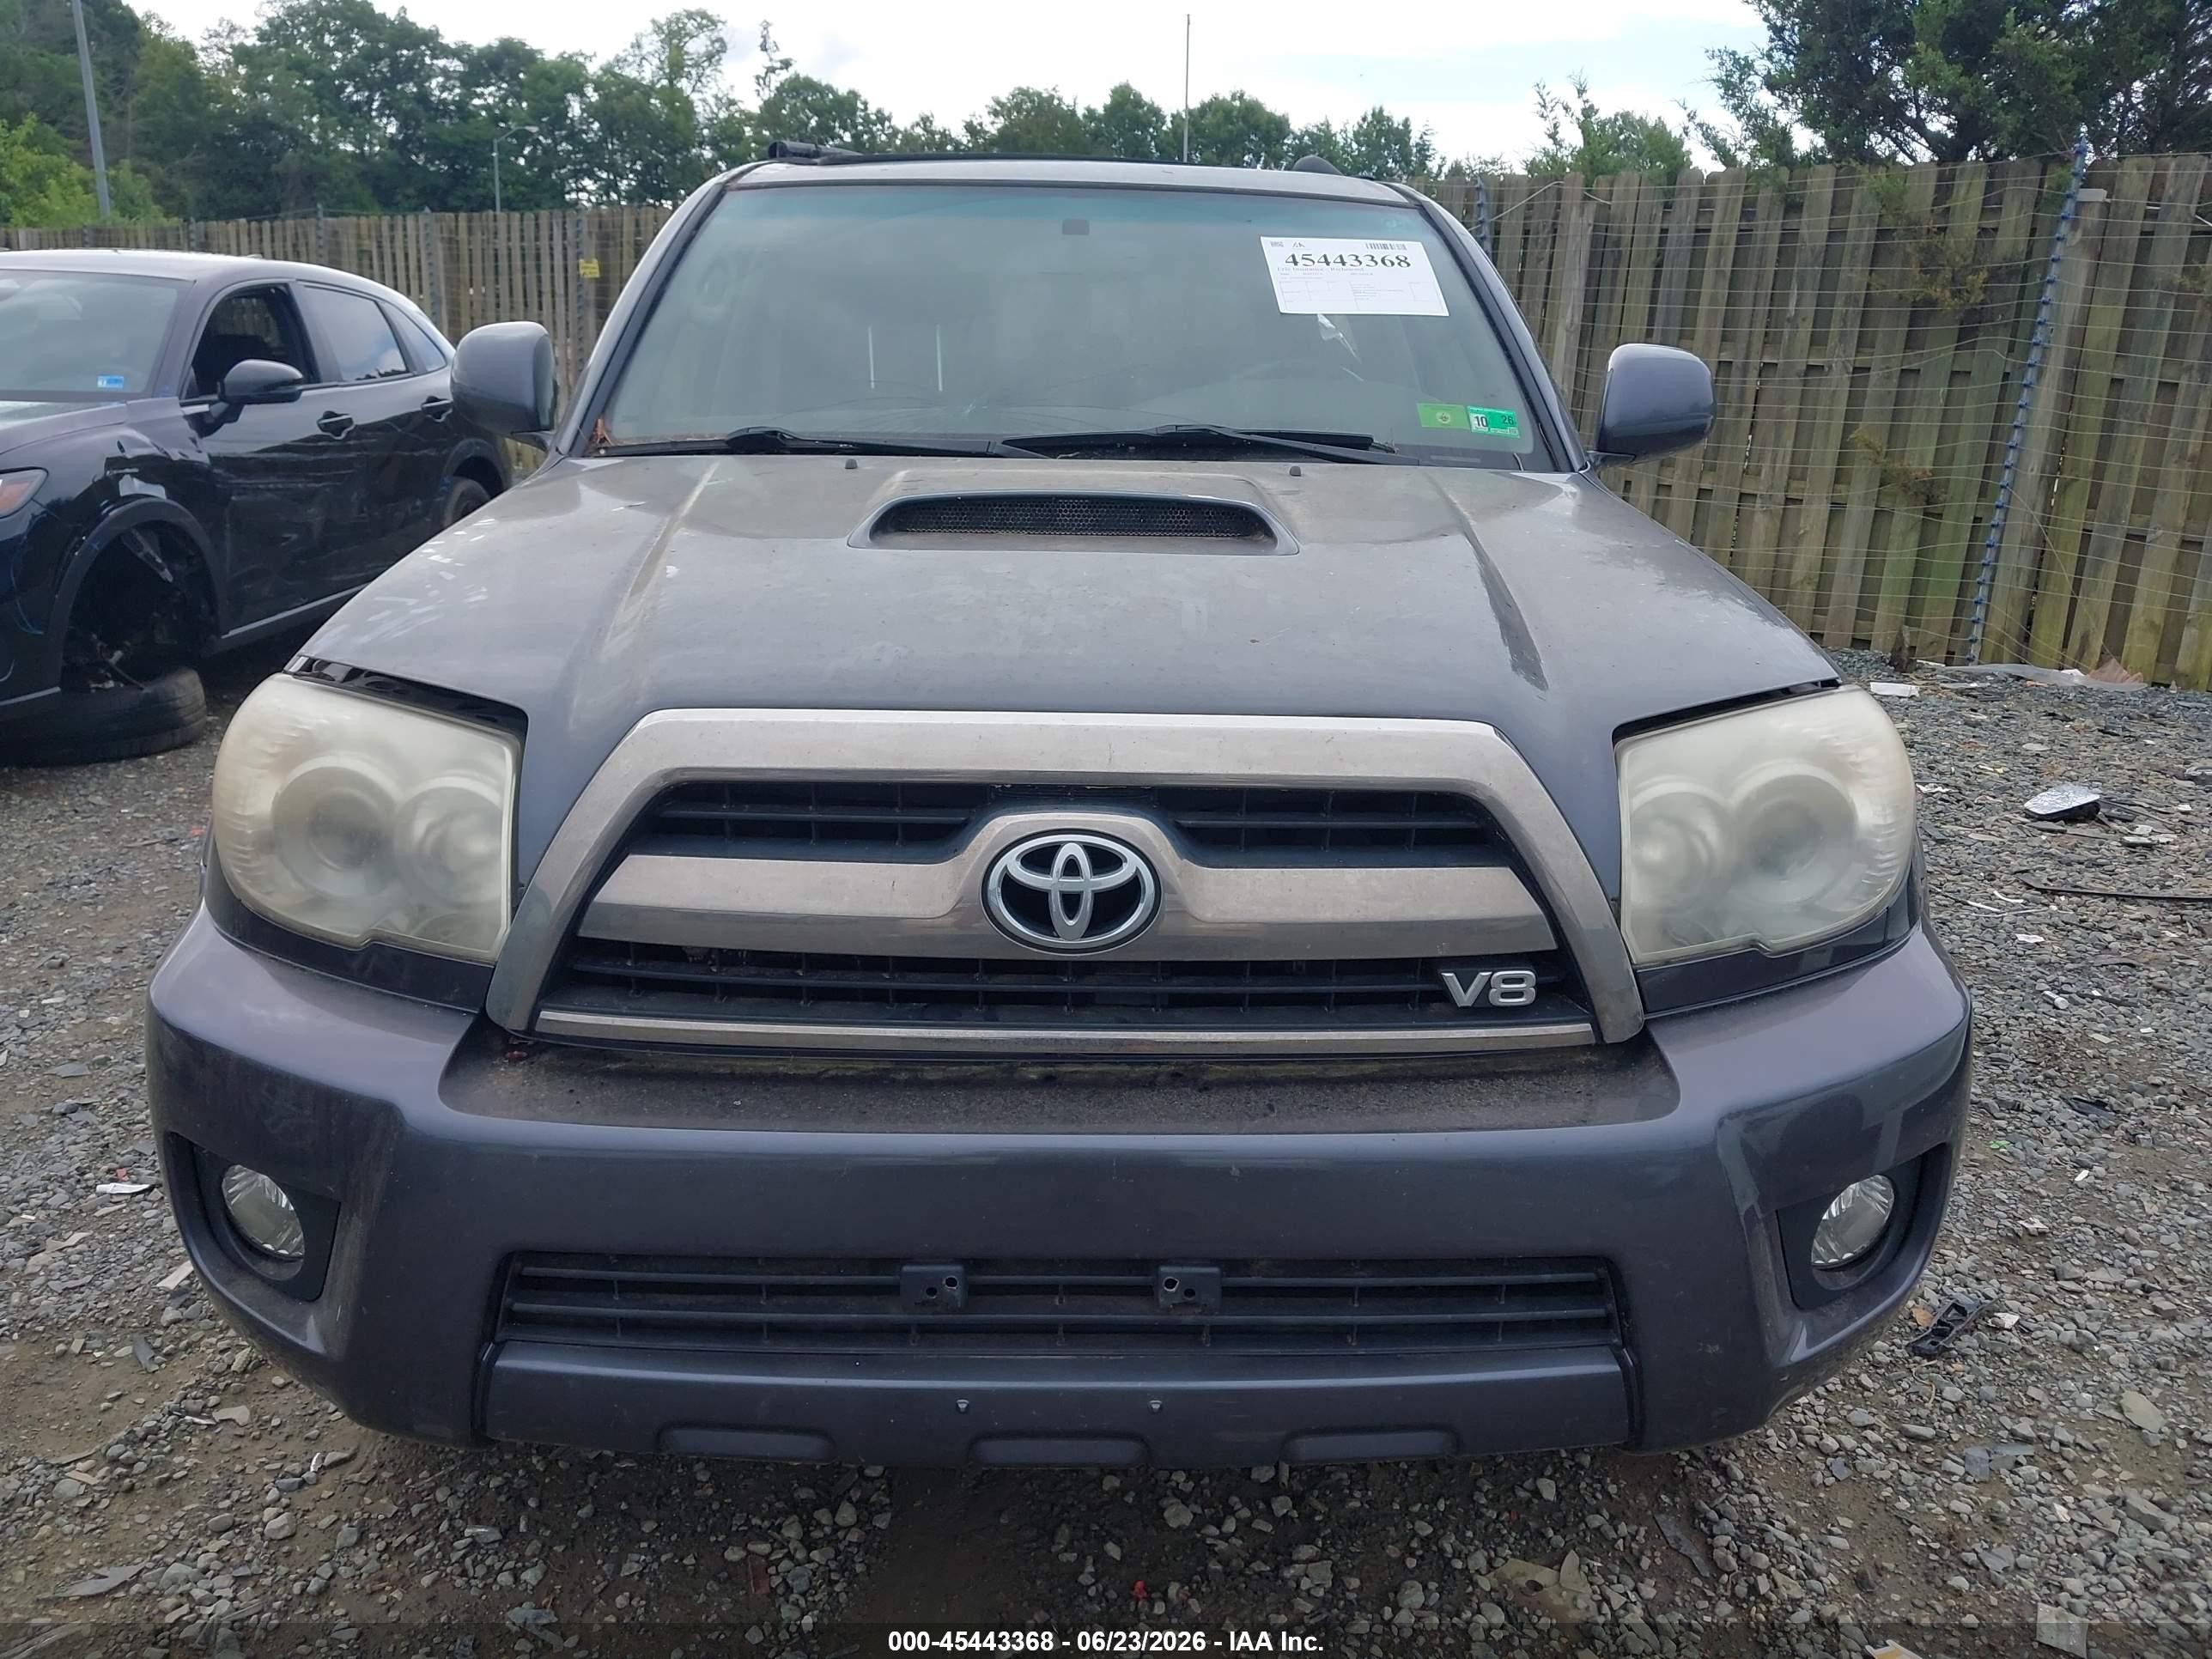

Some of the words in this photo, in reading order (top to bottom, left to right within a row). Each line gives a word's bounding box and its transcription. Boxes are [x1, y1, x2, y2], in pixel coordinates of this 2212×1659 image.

[1285, 253, 1412, 268] 45443368
[1474, 416, 1489, 428] 10
[1501, 415, 1515, 426] 26
[1441, 970, 1537, 1008] V8
